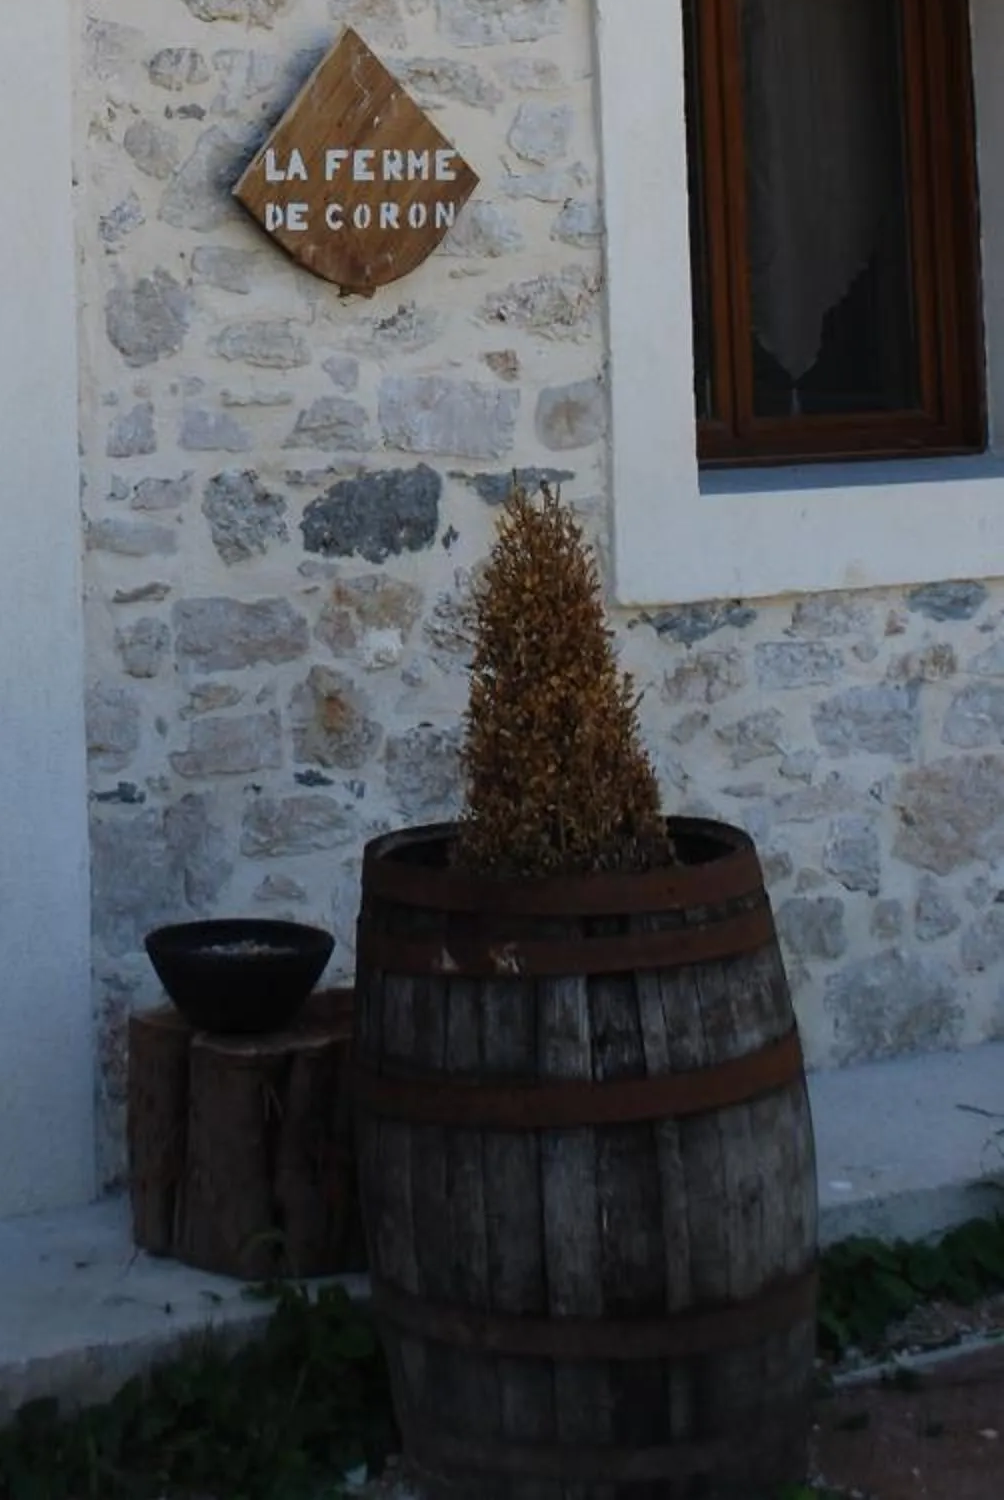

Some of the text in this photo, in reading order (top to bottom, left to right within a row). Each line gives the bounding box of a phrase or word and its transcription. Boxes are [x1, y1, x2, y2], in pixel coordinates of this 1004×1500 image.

[265, 148, 456, 181] LA FERME
[265, 202, 455, 231] DE CORON
